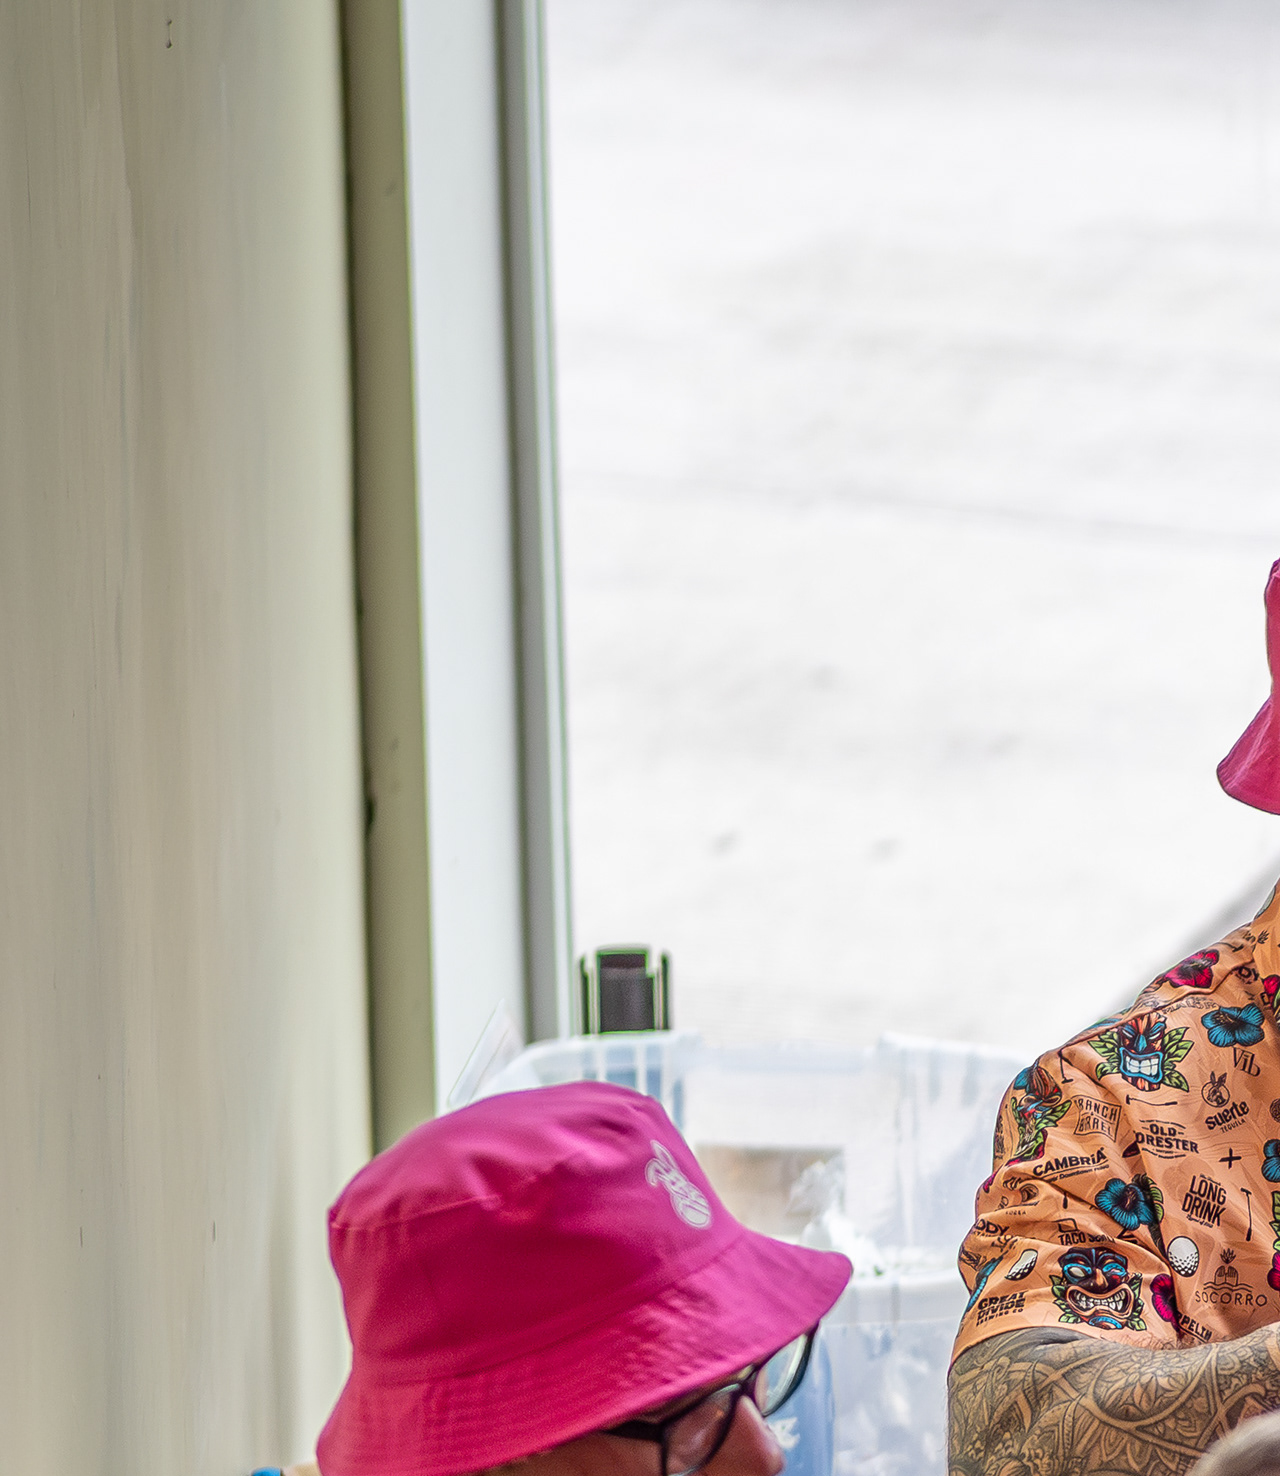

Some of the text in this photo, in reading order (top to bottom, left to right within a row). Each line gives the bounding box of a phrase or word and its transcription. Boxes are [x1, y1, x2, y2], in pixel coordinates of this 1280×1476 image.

[1150, 1123, 1177, 1137] OLD
[1135, 1131, 1199, 1154] ORESTER
[1189, 1175, 1227, 1206] LONG
[1181, 1192, 1226, 1227] DRINK
[1058, 1233, 1086, 1246] TACO
[978, 1291, 1029, 1311] GREAT
[1195, 1290, 1268, 1307] SOCORRO
[976, 1299, 1026, 1319] DIVIDE
